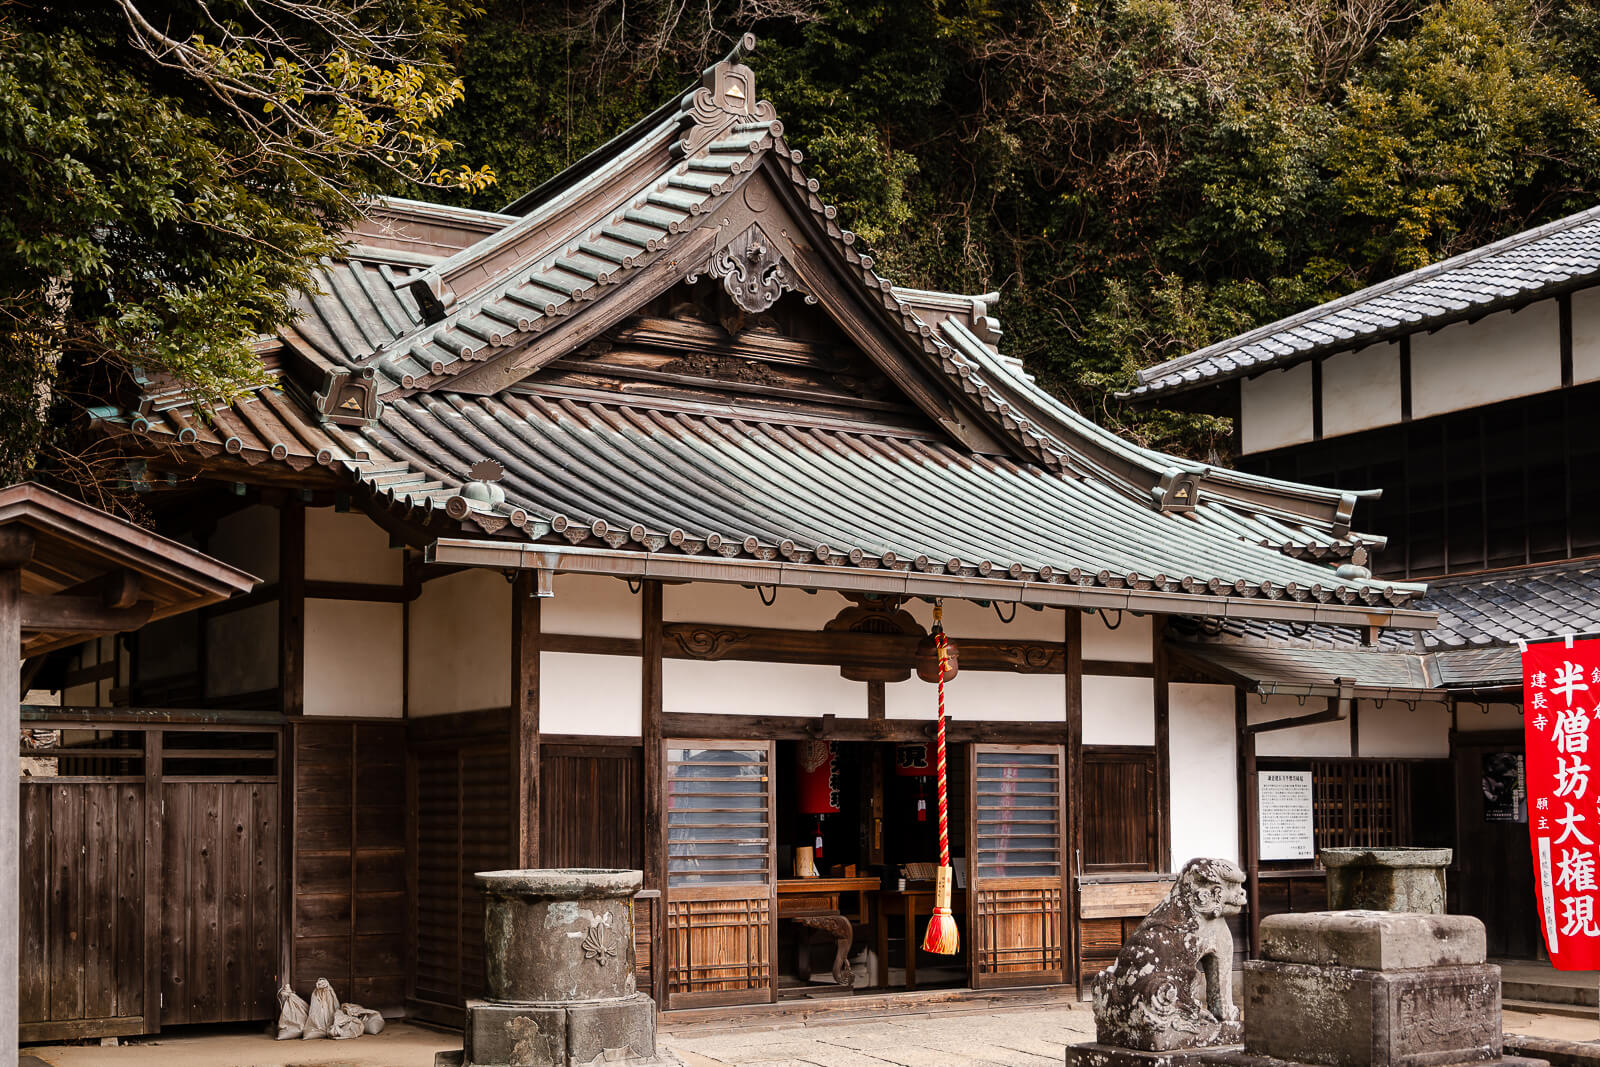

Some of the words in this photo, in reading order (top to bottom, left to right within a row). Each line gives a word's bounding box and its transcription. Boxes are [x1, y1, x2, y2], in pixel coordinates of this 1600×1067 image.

[1530, 670, 1549, 732] 建長寺
[1536, 797, 1550, 830] 願主
[1549, 660, 1600, 937] 半僧坊大権現
